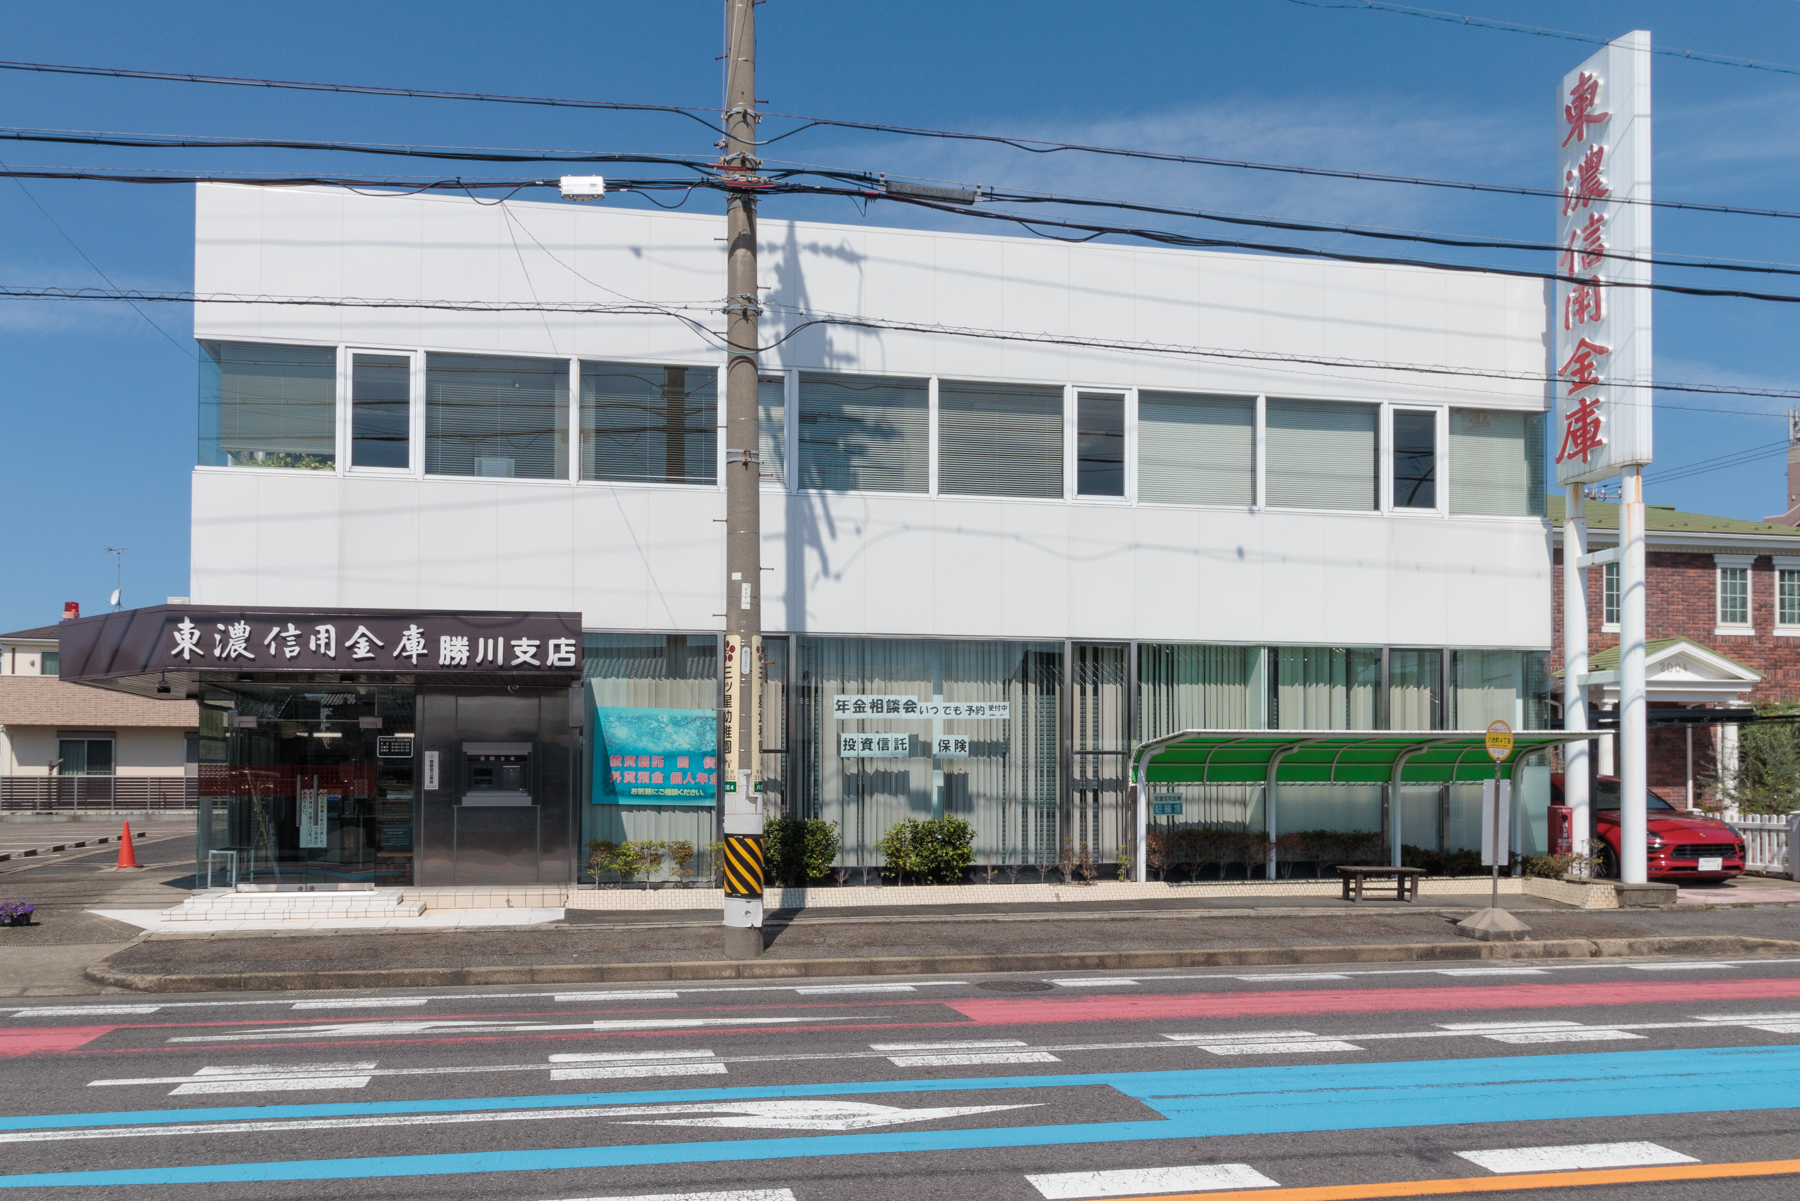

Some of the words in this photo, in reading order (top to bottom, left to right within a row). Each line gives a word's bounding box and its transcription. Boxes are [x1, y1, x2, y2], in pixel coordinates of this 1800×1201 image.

[1555, 71, 1611, 465] 東濃信用金庫
[171, 615, 429, 664] 東濃信用金庫
[438, 634, 577, 667] 勝川支店
[1659, 662, 1688, 673] 2004
[835, 698, 918, 714] 年金相談会
[843, 737, 908, 752] 投資信託
[937, 739, 968, 753] 保険
[609, 755, 665, 768] 投資信託
[609, 771, 665, 784] 外貨預金
[630, 788, 705, 796] お気軽にご相談ください。
[1154, 803, 1182, 814] 駐輪場
